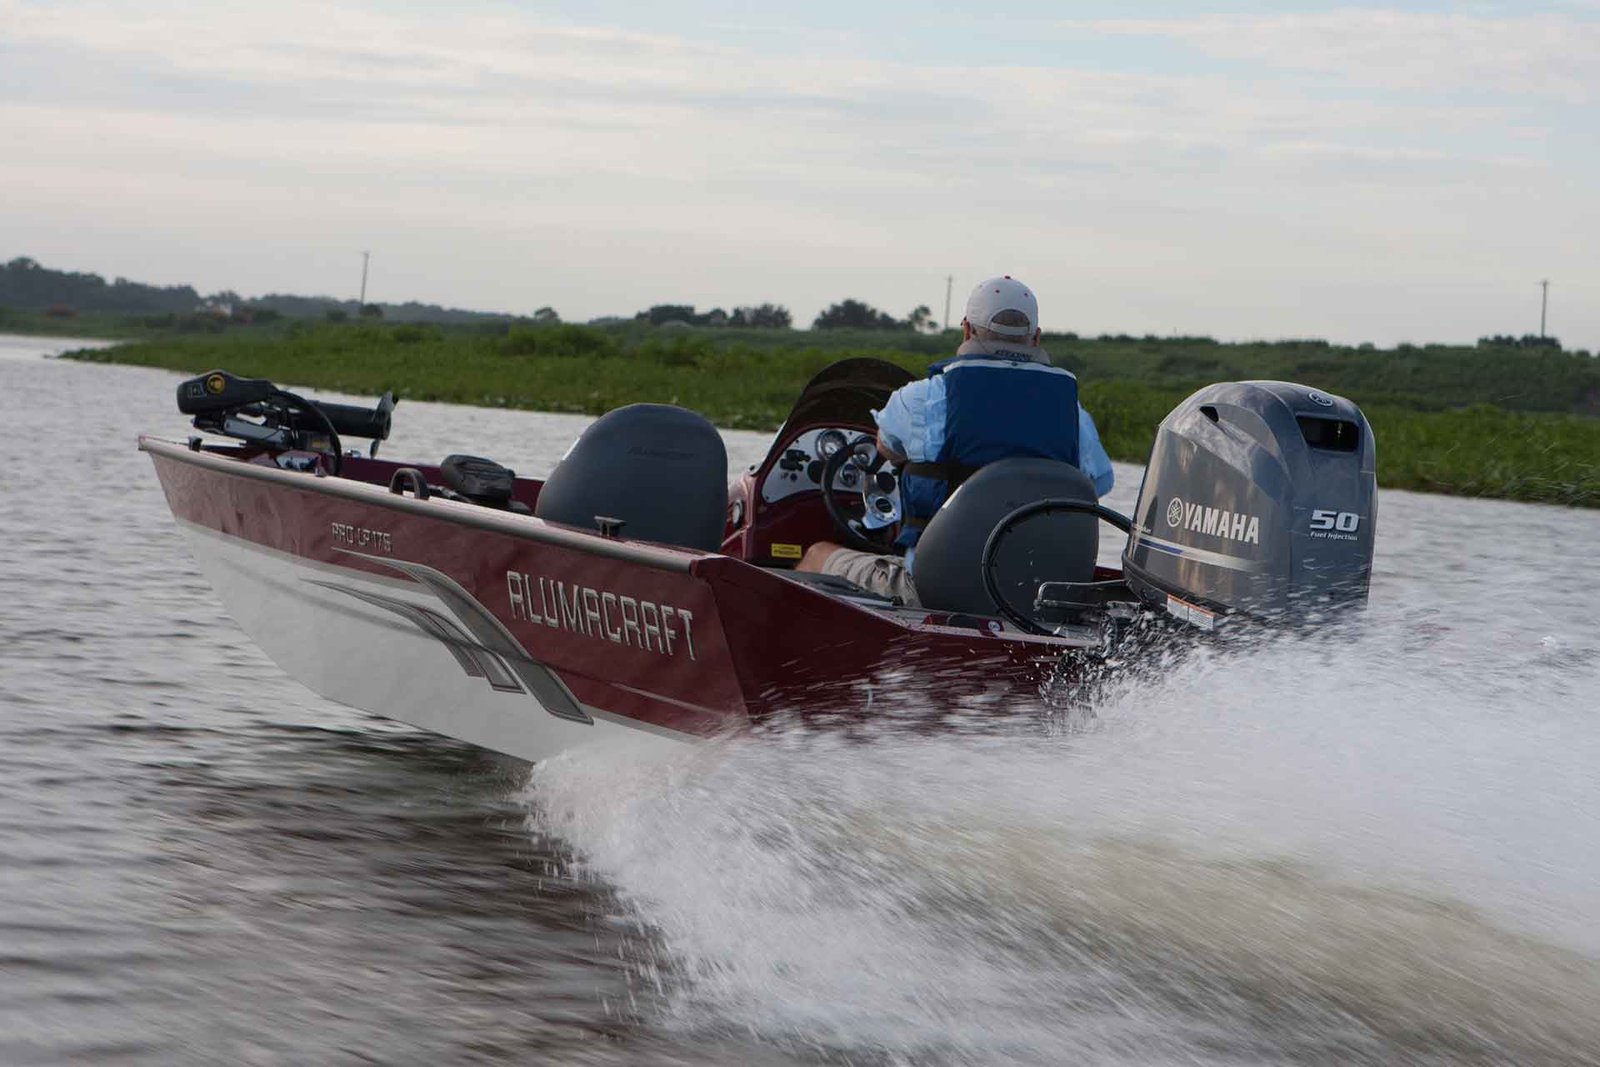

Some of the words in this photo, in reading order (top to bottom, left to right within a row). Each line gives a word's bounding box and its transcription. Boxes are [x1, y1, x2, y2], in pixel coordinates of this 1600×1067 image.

[1184, 502, 1260, 545] YAMAHA
[1309, 509, 1360, 532] 50
[331, 522, 354, 544] PRO
[1310, 531, 1327, 539] Fuel
[1327, 532, 1358, 541] Injection
[506, 570, 696, 661] ALUMACRAFT
